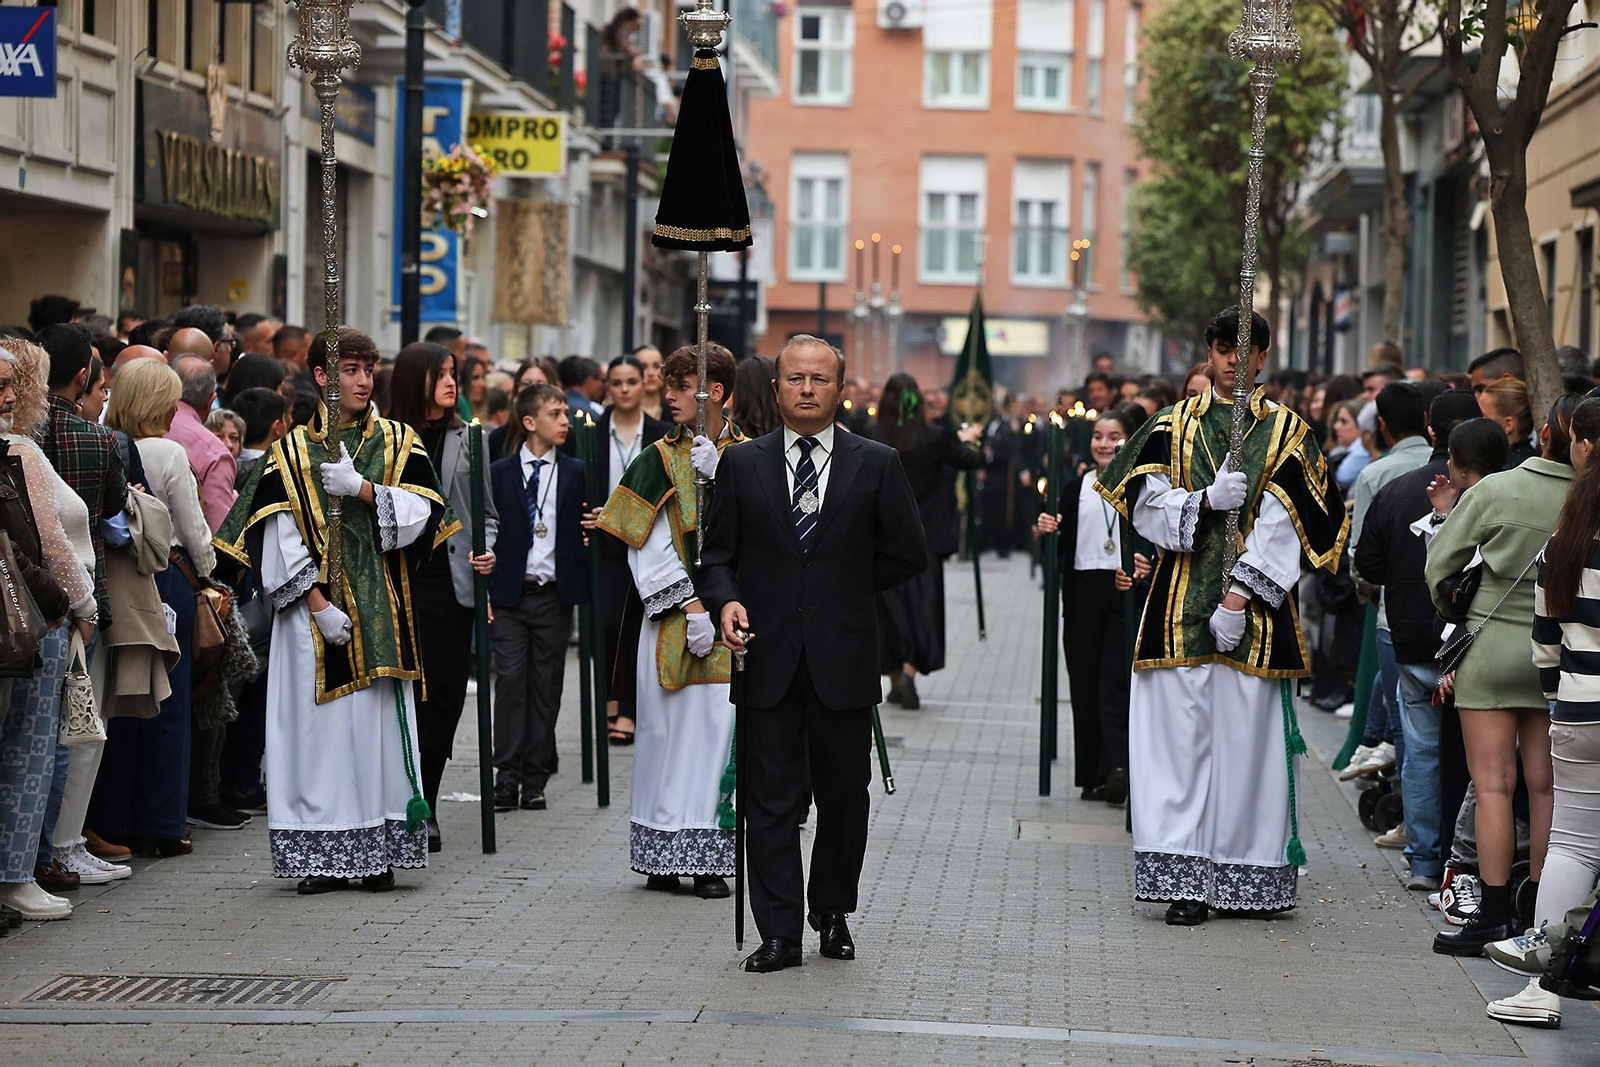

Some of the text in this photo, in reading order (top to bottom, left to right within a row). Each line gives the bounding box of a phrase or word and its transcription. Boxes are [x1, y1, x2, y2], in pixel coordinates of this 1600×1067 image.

[0, 43, 44, 76] XA
[468, 117, 558, 139] OMPRO
[490, 148, 528, 170] RO
